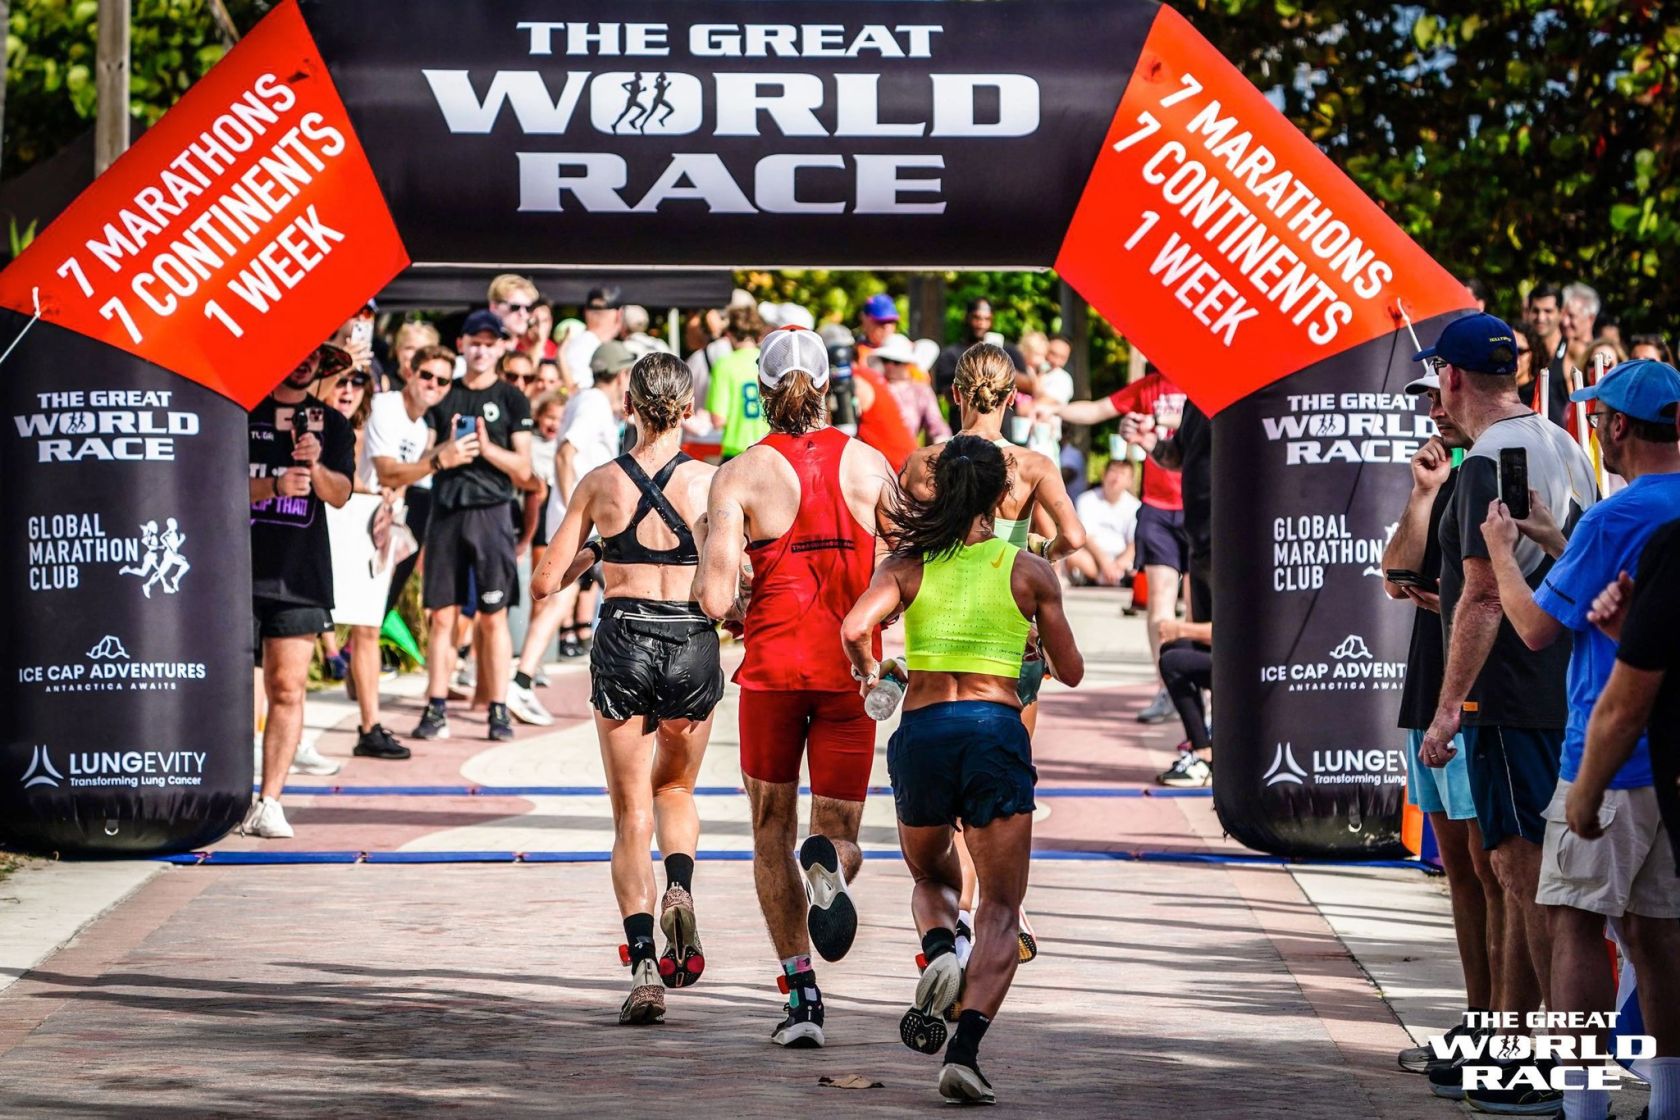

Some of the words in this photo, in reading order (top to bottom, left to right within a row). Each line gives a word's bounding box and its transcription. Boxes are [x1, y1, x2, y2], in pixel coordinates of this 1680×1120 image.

[516, 22, 670, 56] THE
[689, 24, 944, 57] GREAT
[422, 69, 1041, 137] WORLD
[57, 257, 94, 298] 7
[85, 73, 296, 273] MARATHONS
[515, 152, 947, 214] RACE
[1159, 73, 1203, 108] 7
[1186, 100, 1393, 300] MARATHONS
[99, 296, 143, 344] 7
[131, 111, 346, 317] CONTINENTS
[1113, 111, 1161, 152] 7
[1142, 140, 1353, 346] CONTINENTS
[203, 299, 244, 338] 1
[227, 204, 345, 314] WEEK
[1123, 210, 1160, 251] 1
[1148, 232, 1259, 347] WEEK
[37, 391, 84, 409] THE
[90, 390, 172, 407] GREAT
[1287, 394, 1335, 411] THE
[1340, 393, 1419, 410] GREAT
[14, 411, 200, 437] WORLD
[1262, 413, 1441, 440] WORLD
[38, 437, 175, 463] RACE
[1286, 440, 1419, 465] RACE
[28, 513, 106, 540] GLOBAL
[1273, 514, 1351, 541] GLOBAL
[28, 538, 139, 565] MARATHON
[1274, 539, 1383, 567] MARATHON
[29, 565, 79, 591] CLUB
[1273, 566, 1324, 592] CLUB
[19, 667, 43, 683] ICE
[47, 665, 85, 681] CAP
[89, 662, 206, 679] ADVENTURES
[1261, 666, 1287, 682] ICE
[1290, 663, 1329, 679] CAP
[45, 683, 123, 693] ANTARCTICA
[130, 682, 177, 690] AWAITS
[1288, 682, 1366, 692] ANTARCTICA
[69, 752, 206, 775] LUNGEVITY
[70, 777, 138, 788] Transforming
[141, 776, 165, 788] Lung
[168, 775, 202, 786] Cancer
[1314, 774, 1381, 786] Transforming
[1383, 774, 1406, 786] Lung
